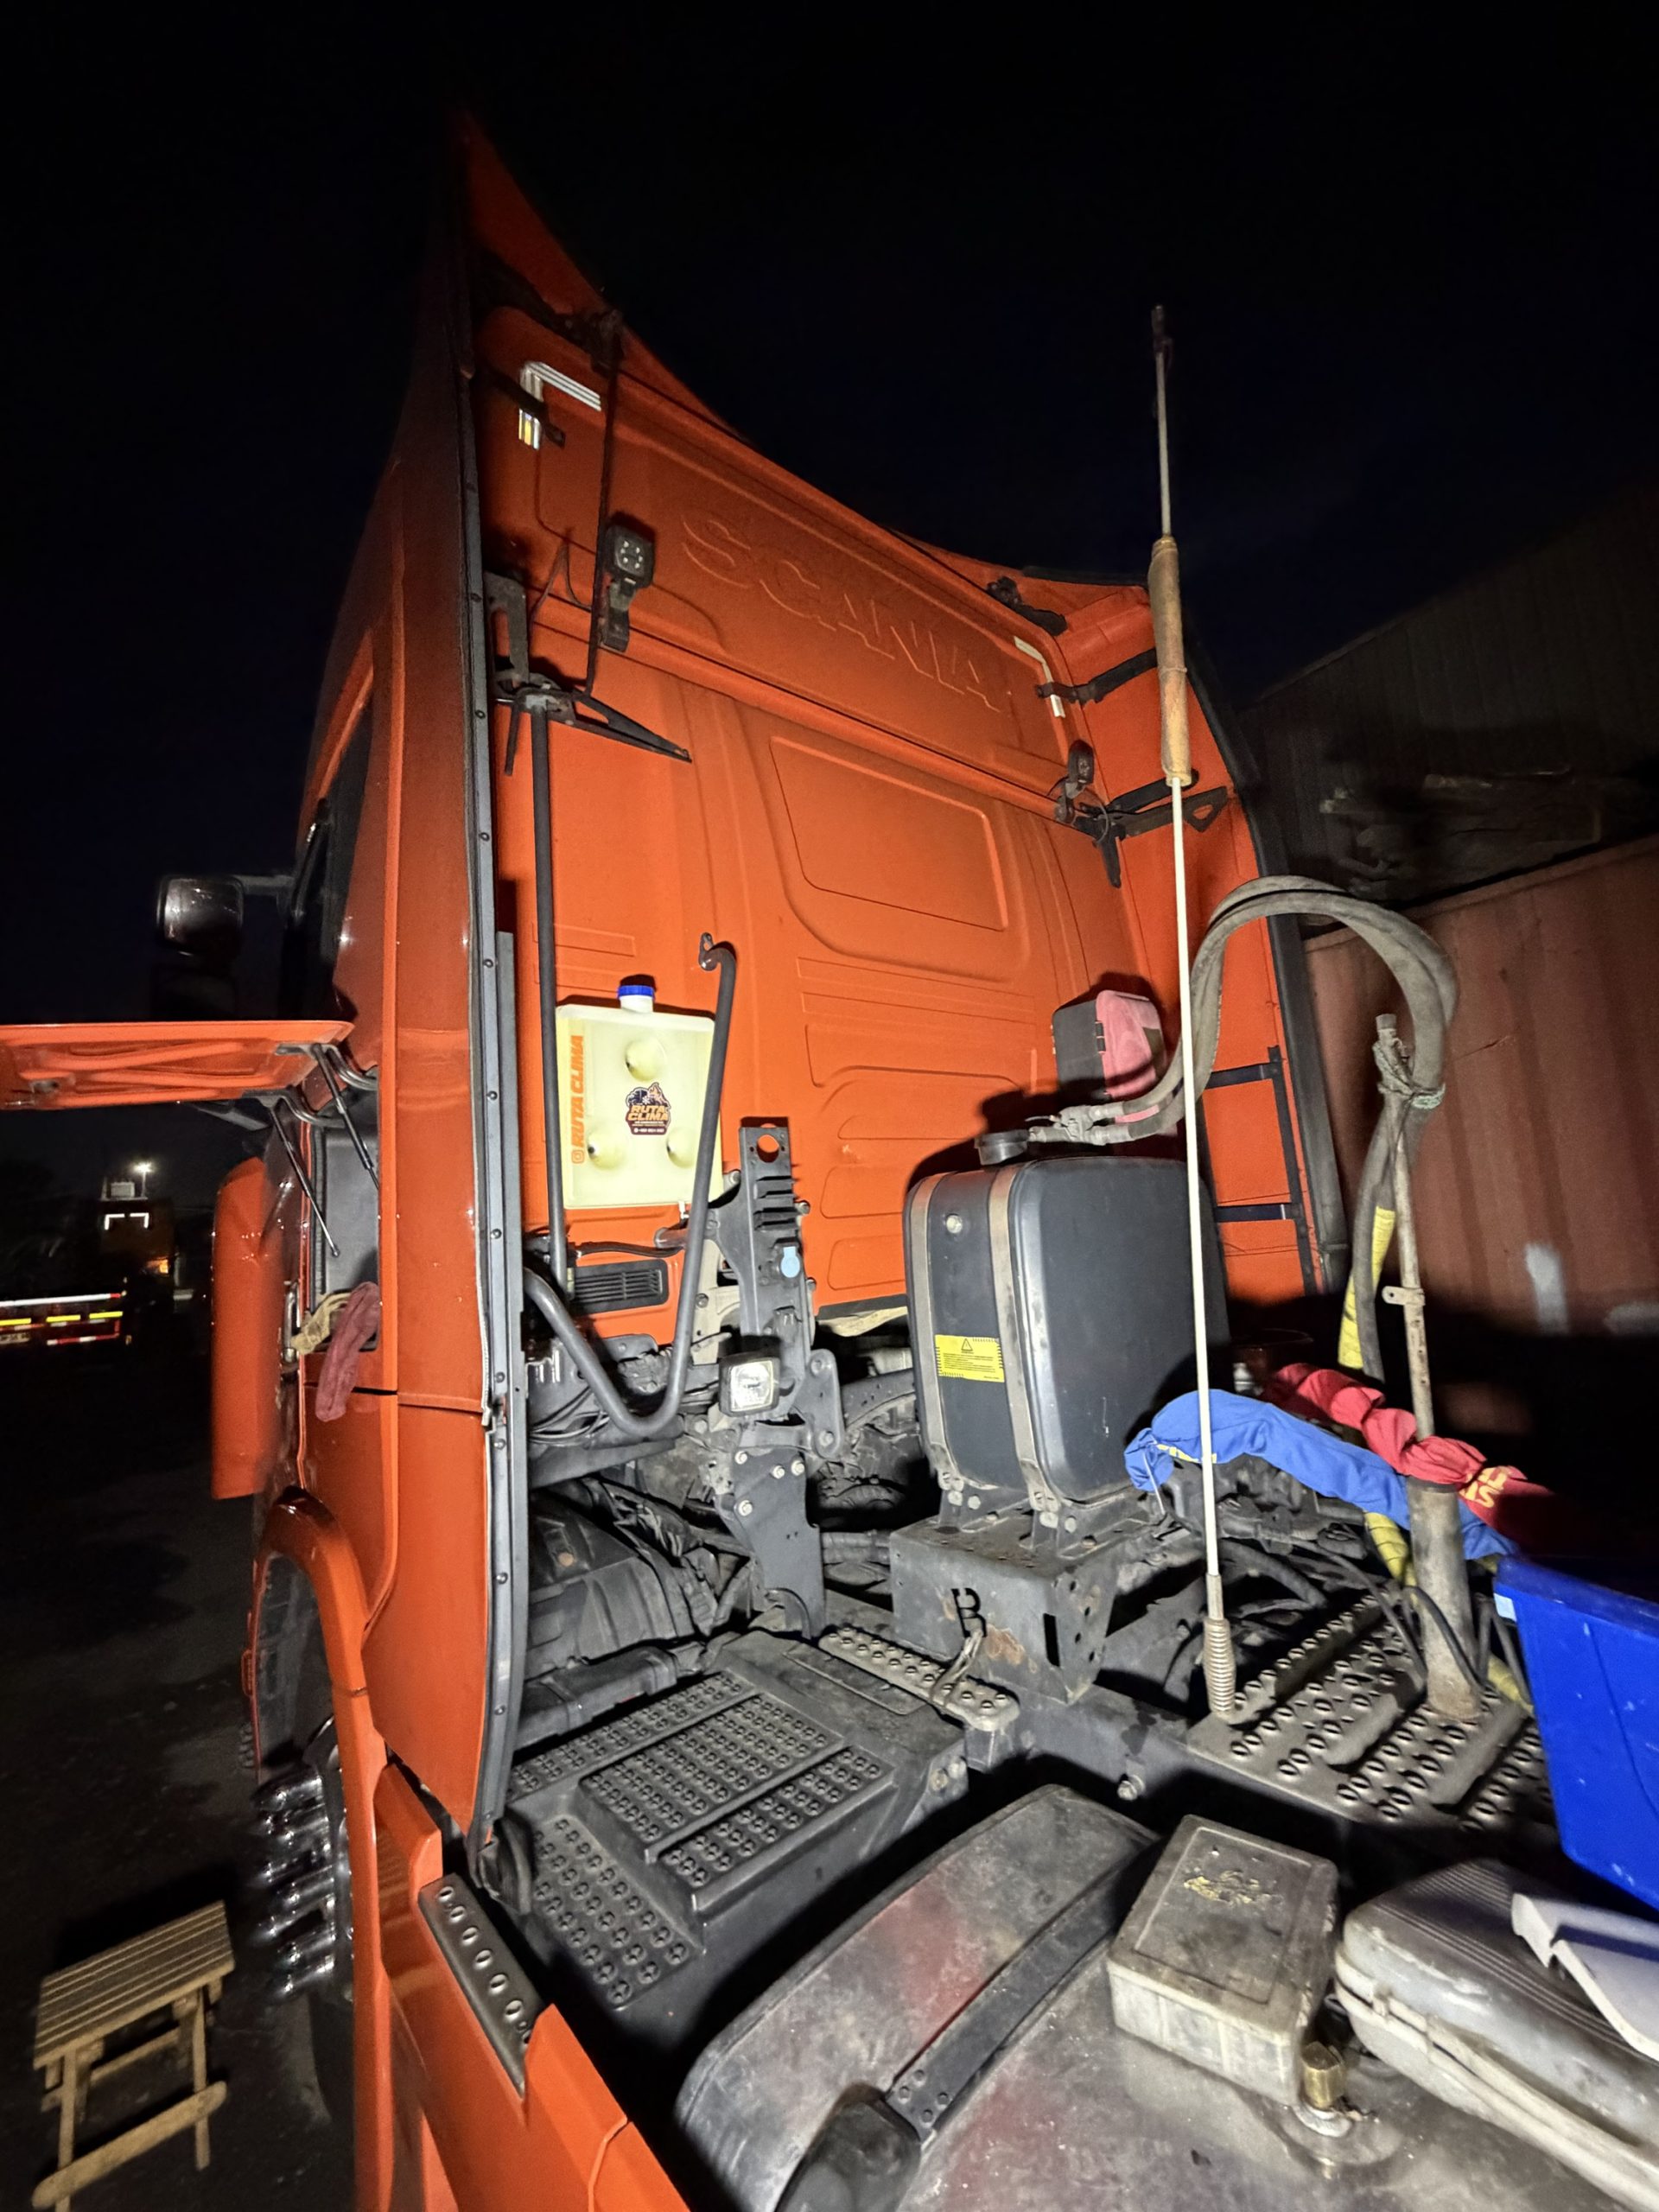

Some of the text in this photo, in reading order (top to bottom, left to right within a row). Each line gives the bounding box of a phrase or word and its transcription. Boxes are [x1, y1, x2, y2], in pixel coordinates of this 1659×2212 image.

[570, 1035, 584, 1148] RUTA CLIMA
[630, 1105, 665, 1114] RUTA
